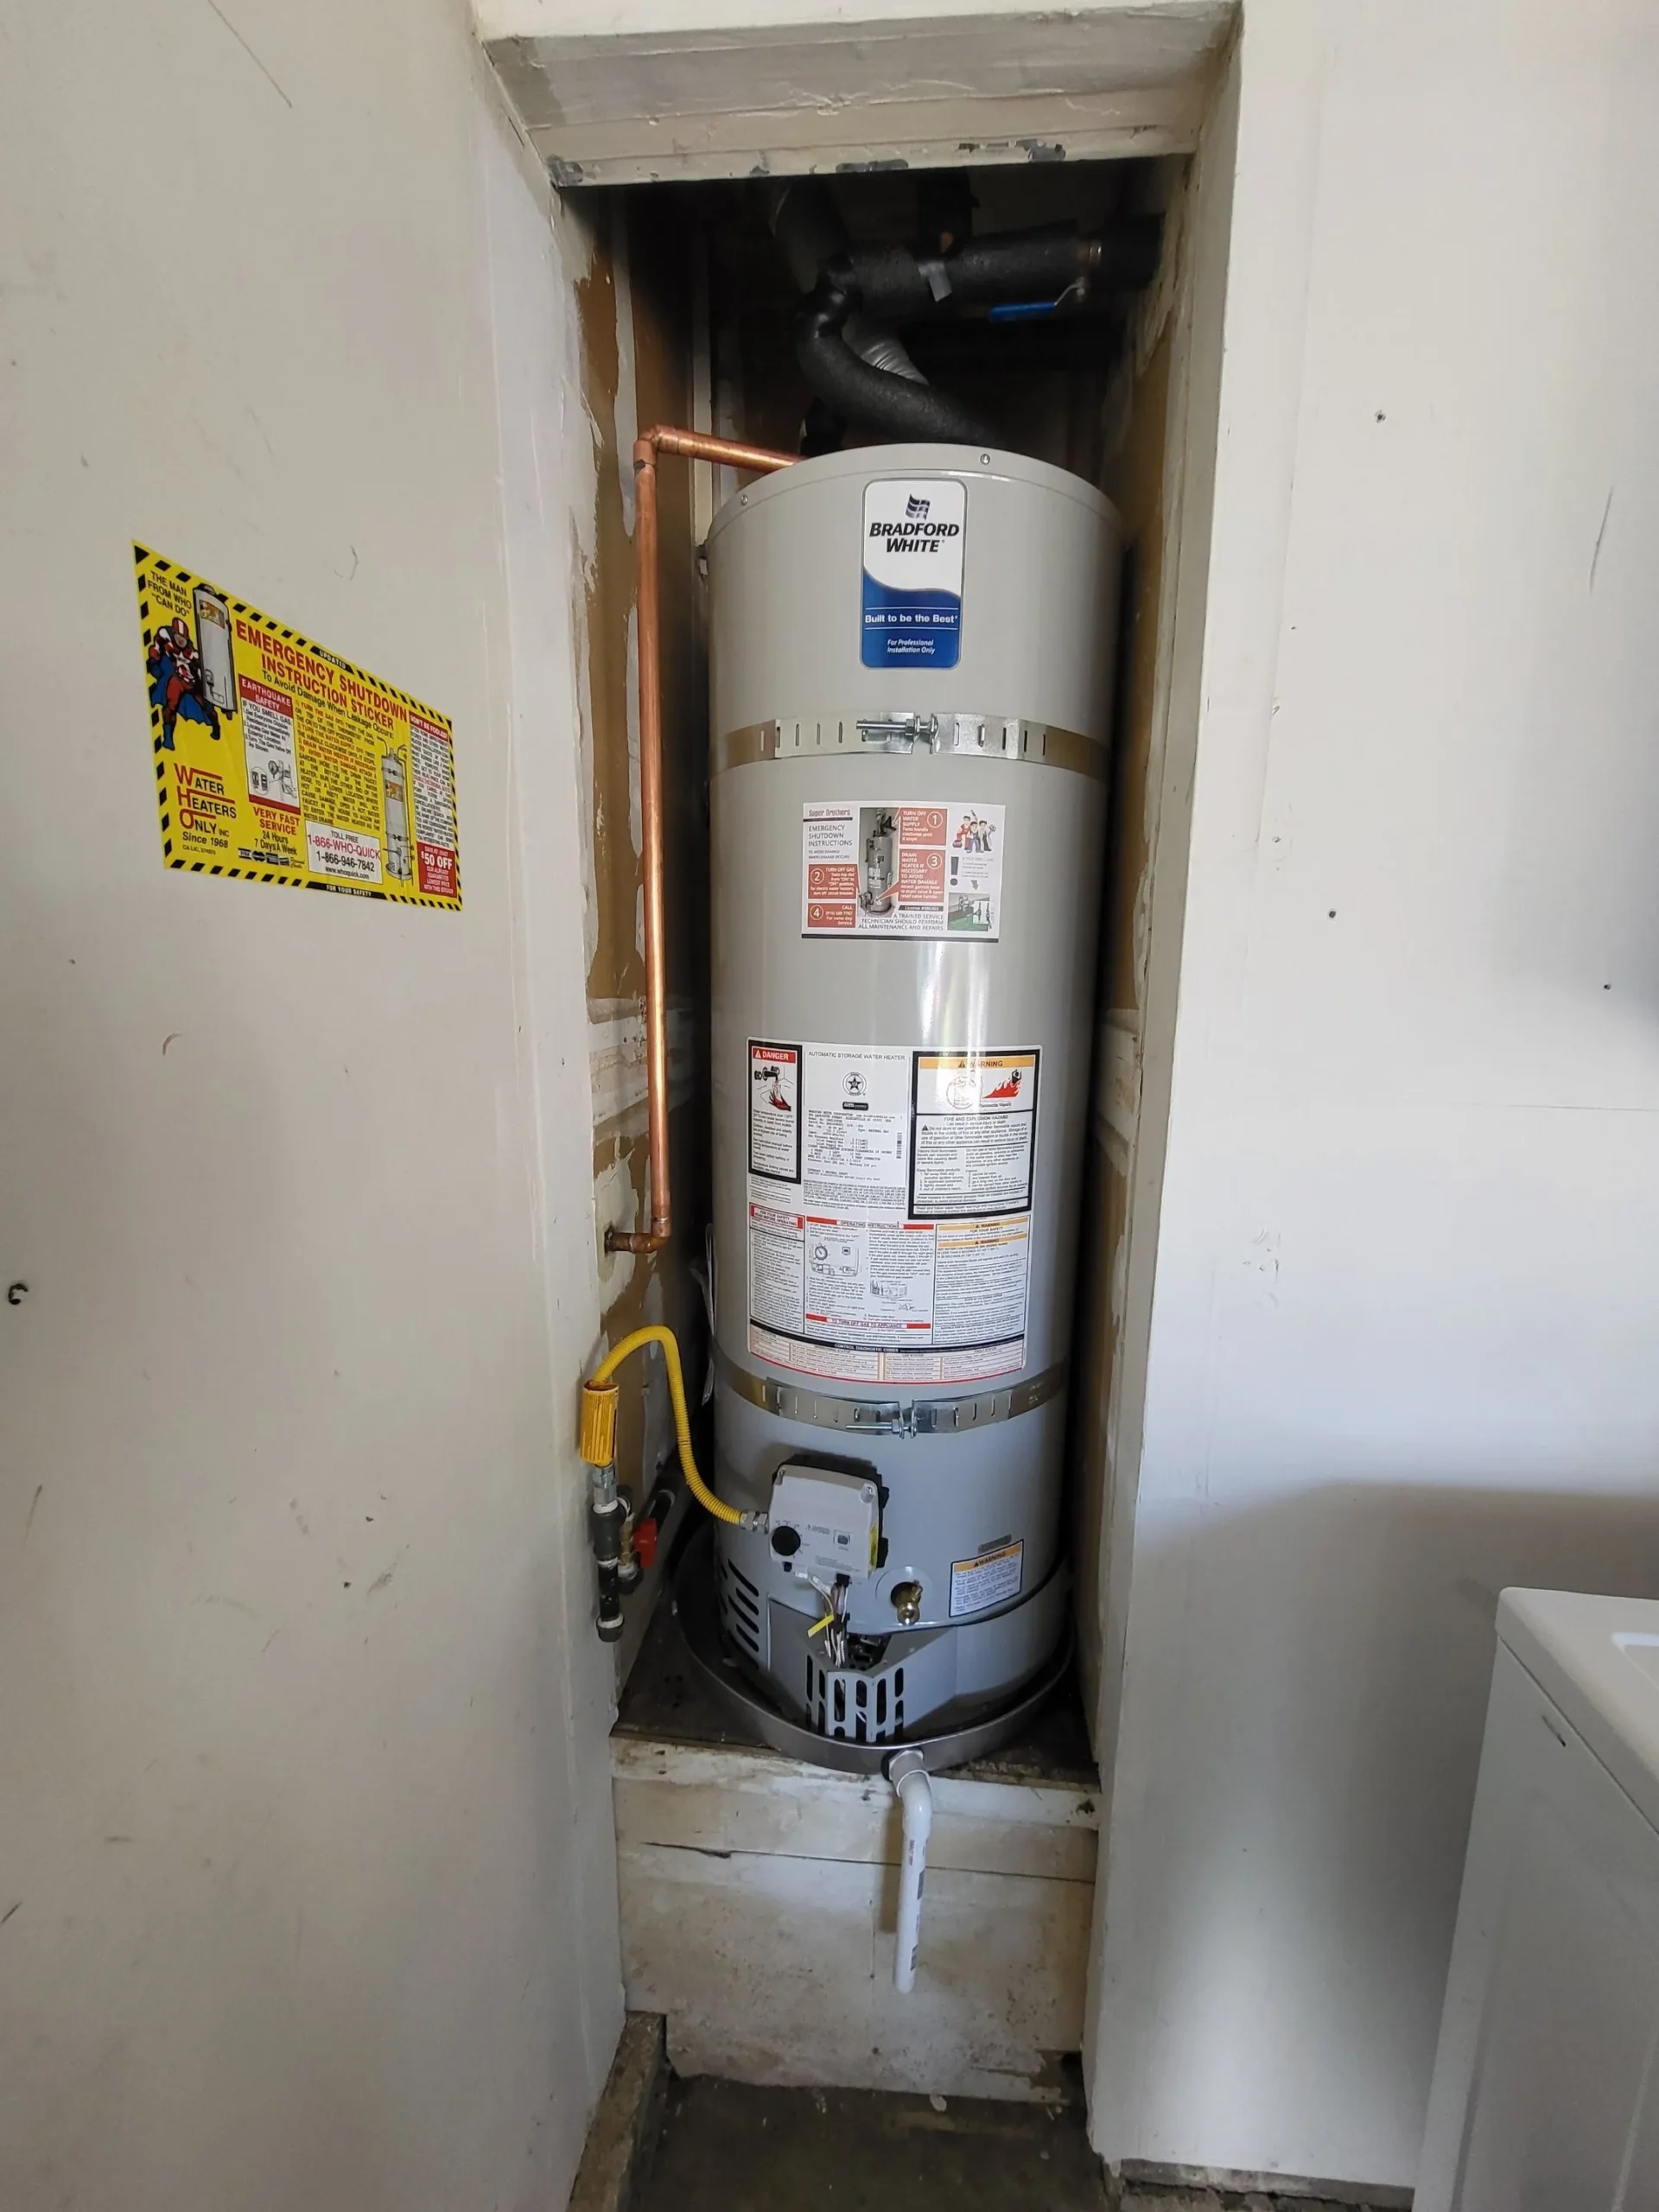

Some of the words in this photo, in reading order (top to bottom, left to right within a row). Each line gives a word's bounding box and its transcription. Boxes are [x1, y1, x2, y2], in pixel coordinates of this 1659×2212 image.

[869, 523, 959, 537] BRADFORD
[887, 538, 939, 552] WHITE
[149, 570, 166, 586] THE
[169, 581, 187, 597] MAN
[148, 580, 171, 599] FROM
[174, 591, 192, 609] WHO
[865, 614, 885, 623] Built
[933, 614, 954, 623] Best
[319, 650, 346, 669] UPDATED
[236, 619, 334, 685] EMERGENCY
[340, 674, 407, 723] SHUTDOWN
[242, 678, 290, 707] EARTHQUAKE
[262, 654, 347, 708] INSTRUCTION
[351, 700, 393, 730] STICKER
[262, 671, 271, 680] To
[274, 676, 295, 692] Avoid
[298, 687, 326, 709] Damage
[327, 701, 346, 717] When
[346, 709, 372, 729] Leakage
[256, 695, 280, 709] SAFETY
[249, 702, 260, 713] YOU
[262, 709, 278, 720] SMELL
[174, 763, 225, 795] WATER
[177, 785, 237, 818] HEATERS
[180, 809, 216, 834] ONLY
[253, 806, 276, 820] VERY
[280, 813, 300, 826] FAST
[932, 815, 937, 824] 1
[260, 819, 296, 836] SERVICE
[182, 832, 207, 844] Since
[211, 837, 228, 849] 1968
[263, 830, 270, 839] 24
[272, 832, 288, 844] Hours
[331, 830, 345, 840] TOLL
[346, 835, 359, 843] FREE
[254, 838, 258, 847] 7
[261, 840, 276, 852] Days
[283, 843, 297, 855] Week
[308, 834, 380, 860] 1-866-WHO-QUICK
[317, 851, 375, 872] 1-866-946-7842
[421, 851, 435, 866] $50
[437, 855, 452, 870] OFF
[931, 856, 938, 866] 3
[325, 867, 369, 879] www.whoquick.com
[814, 872, 820, 881] 2
[813, 908, 819, 918] 4
[763, 1052, 789, 1060] DANGER
